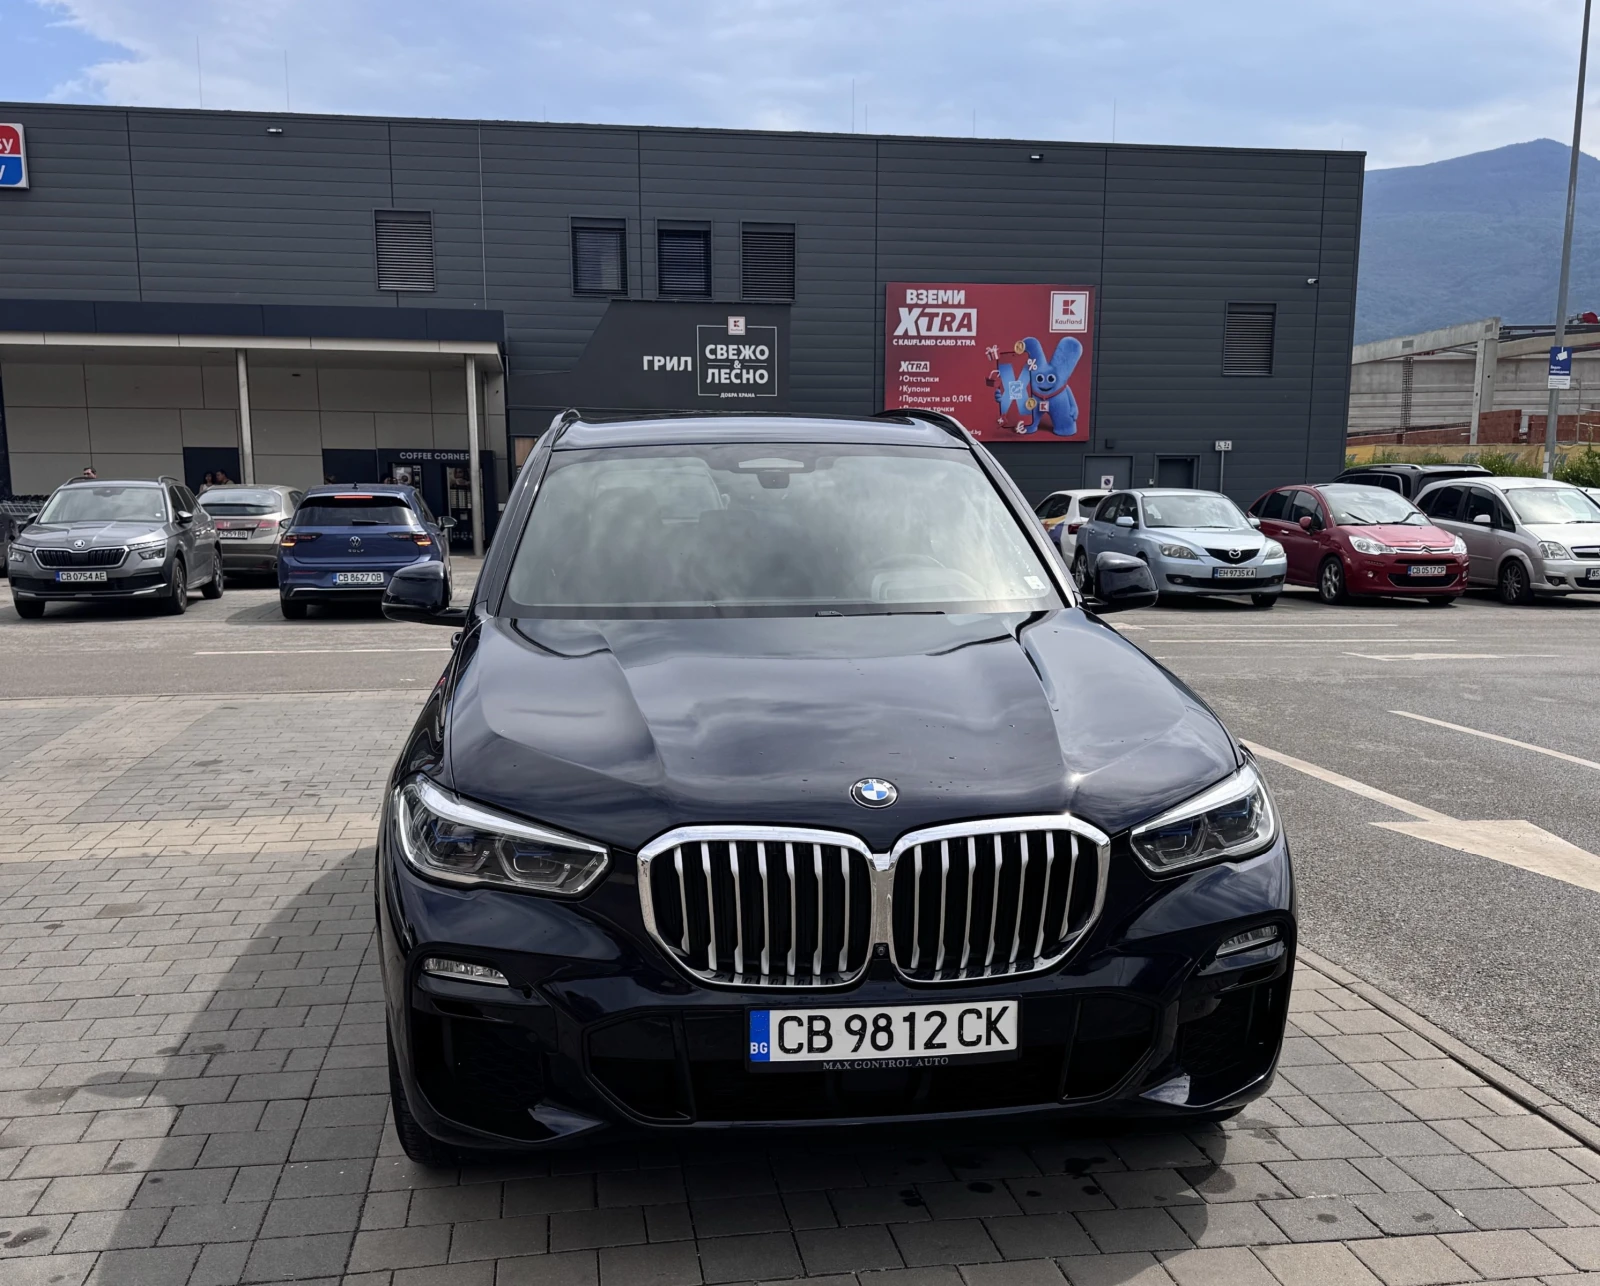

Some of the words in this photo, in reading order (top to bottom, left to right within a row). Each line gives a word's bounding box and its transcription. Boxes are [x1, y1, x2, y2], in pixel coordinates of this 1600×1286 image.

[906, 289, 966, 305] ВЗЕМИ
[893, 307, 977, 336] XTRA
[898, 338, 936, 346] KAUFLAND
[705, 344, 770, 360] СВЕЖО
[643, 355, 692, 371] ГРИЛ
[733, 360, 742, 369] &
[899, 361, 930, 372] XTRA
[706, 368, 769, 384] ЛЕСНО
[903, 375, 940, 383] Отстъпки
[902, 385, 931, 394] Купони
[902, 395, 940, 403] Продукти
[952, 395, 972, 403] 0,01€
[400, 452, 432, 460] COFFEE
[73, 572, 93, 580] 0754
[750, 1042, 768, 1054] BG
[777, 1014, 834, 1055] CB
[844, 1010, 948, 1053] 9812
[957, 1006, 1010, 1047] CK
[822, 1061, 851, 1070] MAX
[854, 1059, 913, 1069] CONTROL
[916, 1057, 949, 1067] AUTO
